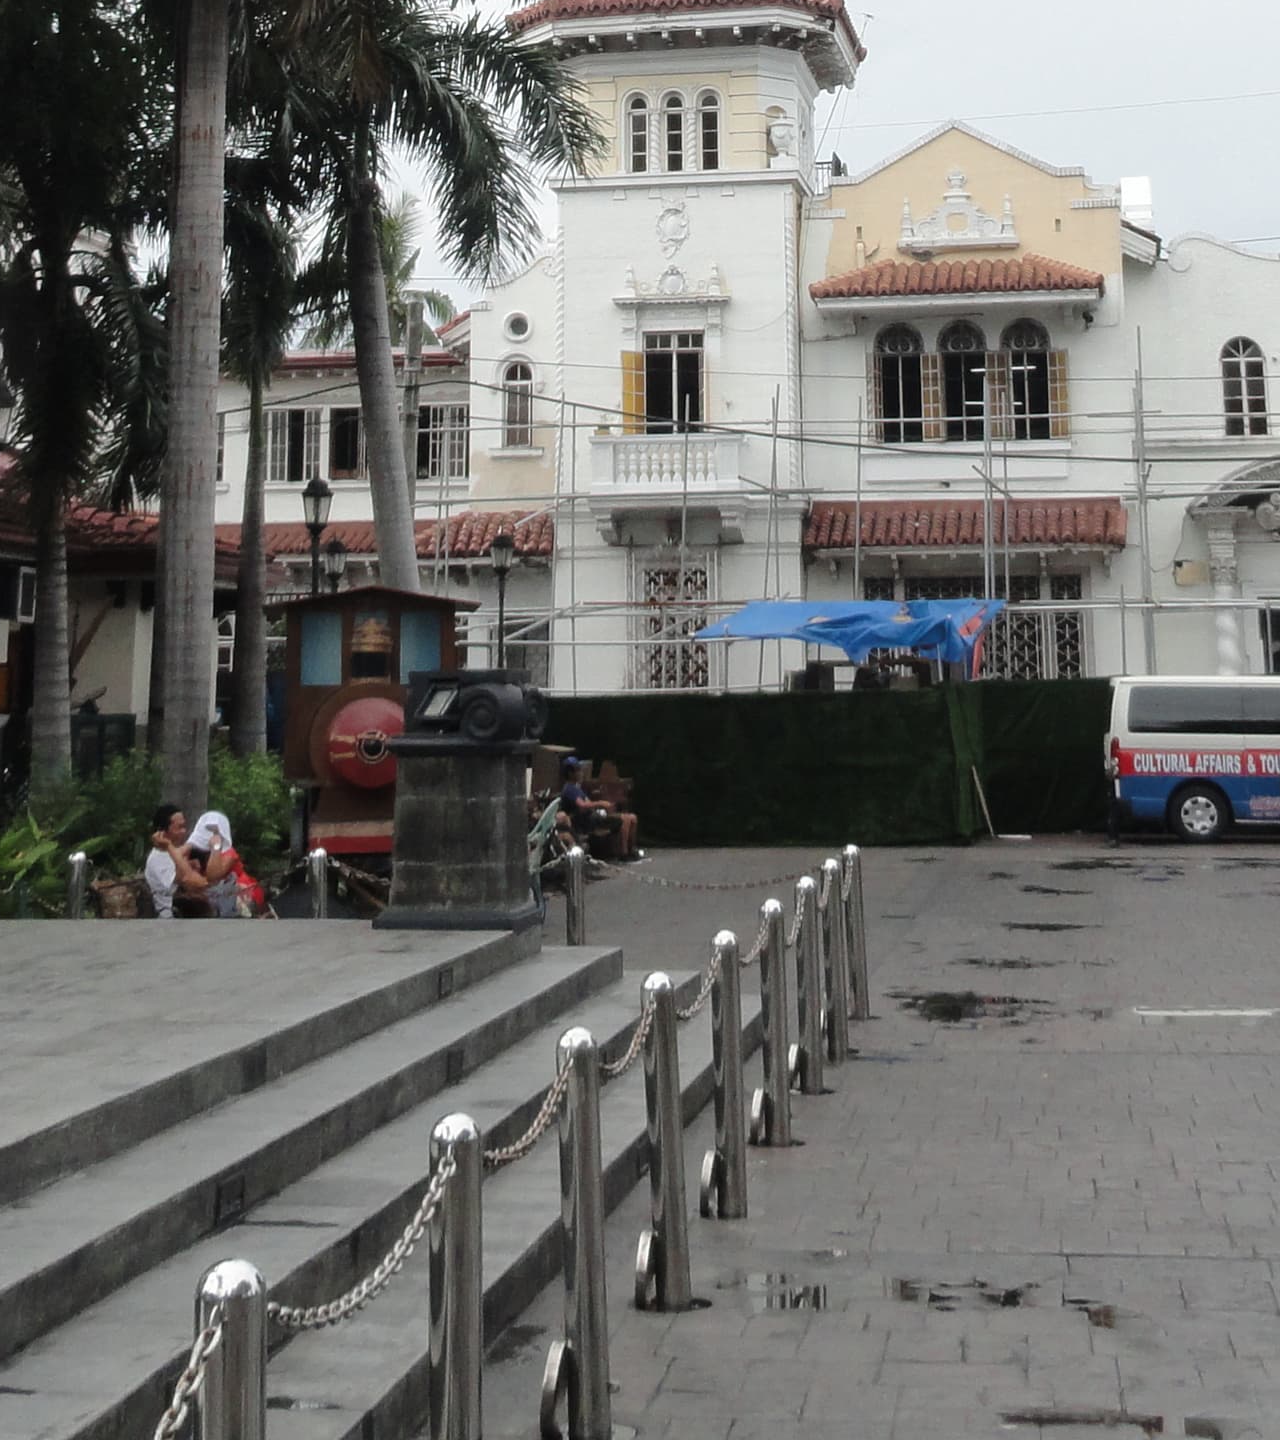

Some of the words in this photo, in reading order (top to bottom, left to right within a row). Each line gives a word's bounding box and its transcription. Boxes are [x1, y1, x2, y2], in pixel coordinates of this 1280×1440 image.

[1133, 752, 1193, 773] CULTURAL
[1195, 754, 1241, 774] AFFAIRS
[1247, 754, 1257, 773] &
